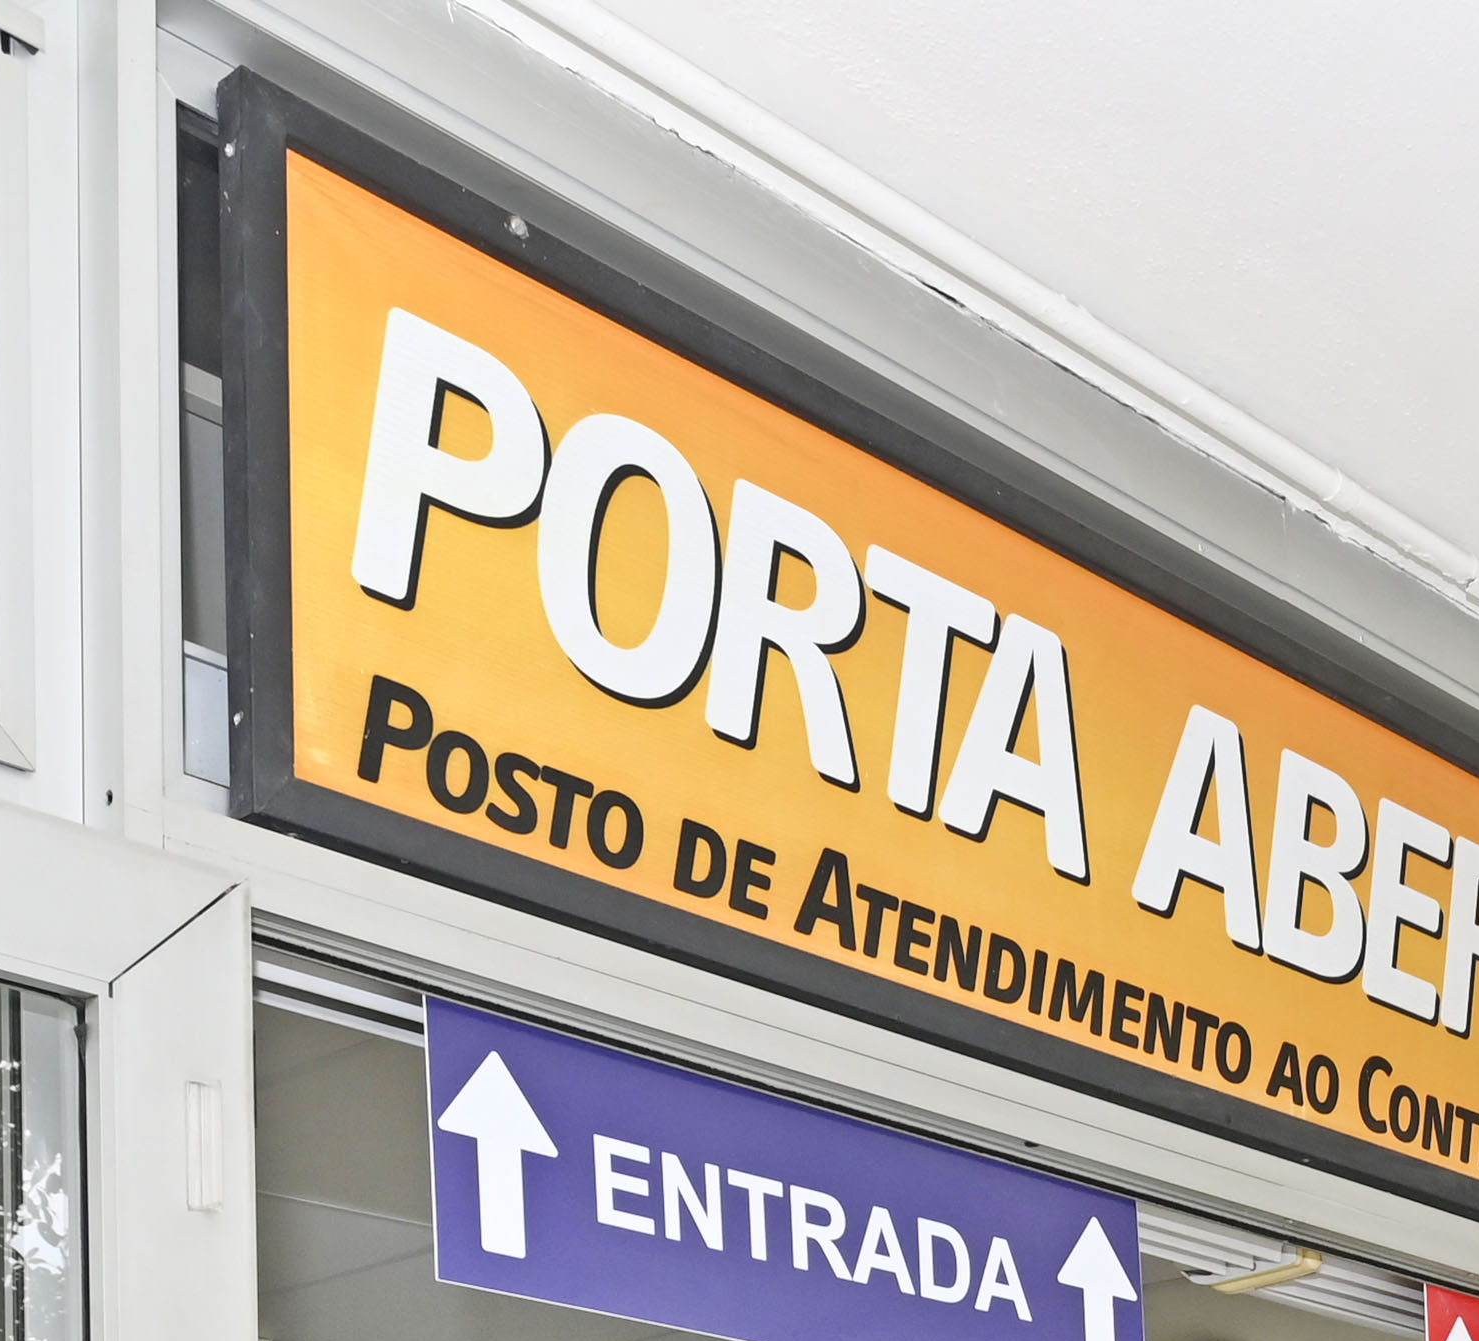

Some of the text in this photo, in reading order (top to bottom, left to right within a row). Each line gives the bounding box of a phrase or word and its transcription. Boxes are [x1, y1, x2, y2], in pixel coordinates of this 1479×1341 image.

[351, 306, 1091, 884] PORTA
[357, 673, 646, 849] POSTO
[673, 818, 777, 920] DE
[794, 847, 1252, 1086] ATENDIMENTO
[1266, 1041, 1339, 1115] AO
[593, 1133, 1034, 1322] ENTRADA
